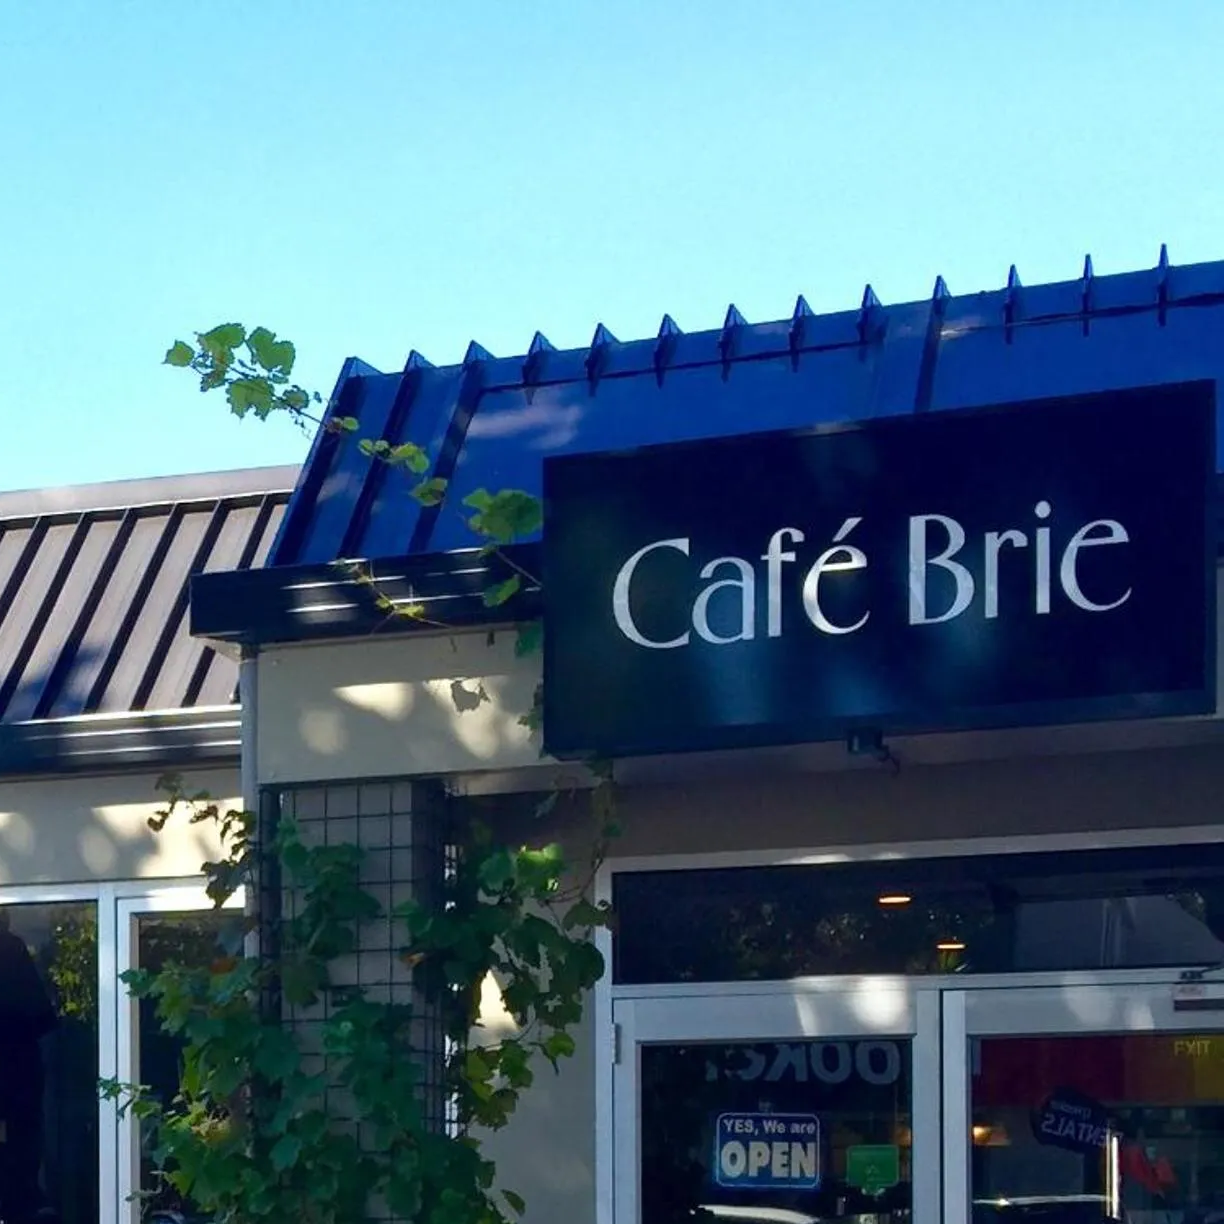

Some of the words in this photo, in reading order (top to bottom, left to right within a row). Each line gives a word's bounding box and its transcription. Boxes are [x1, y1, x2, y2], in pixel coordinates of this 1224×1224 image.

[612, 516, 870, 649] Café
[908, 500, 1132, 626] Brie
[723, 1119, 758, 1136] YES,
[762, 1119, 786, 1134] We
[790, 1122, 816, 1134] are
[720, 1140, 816, 1178] OPEN
